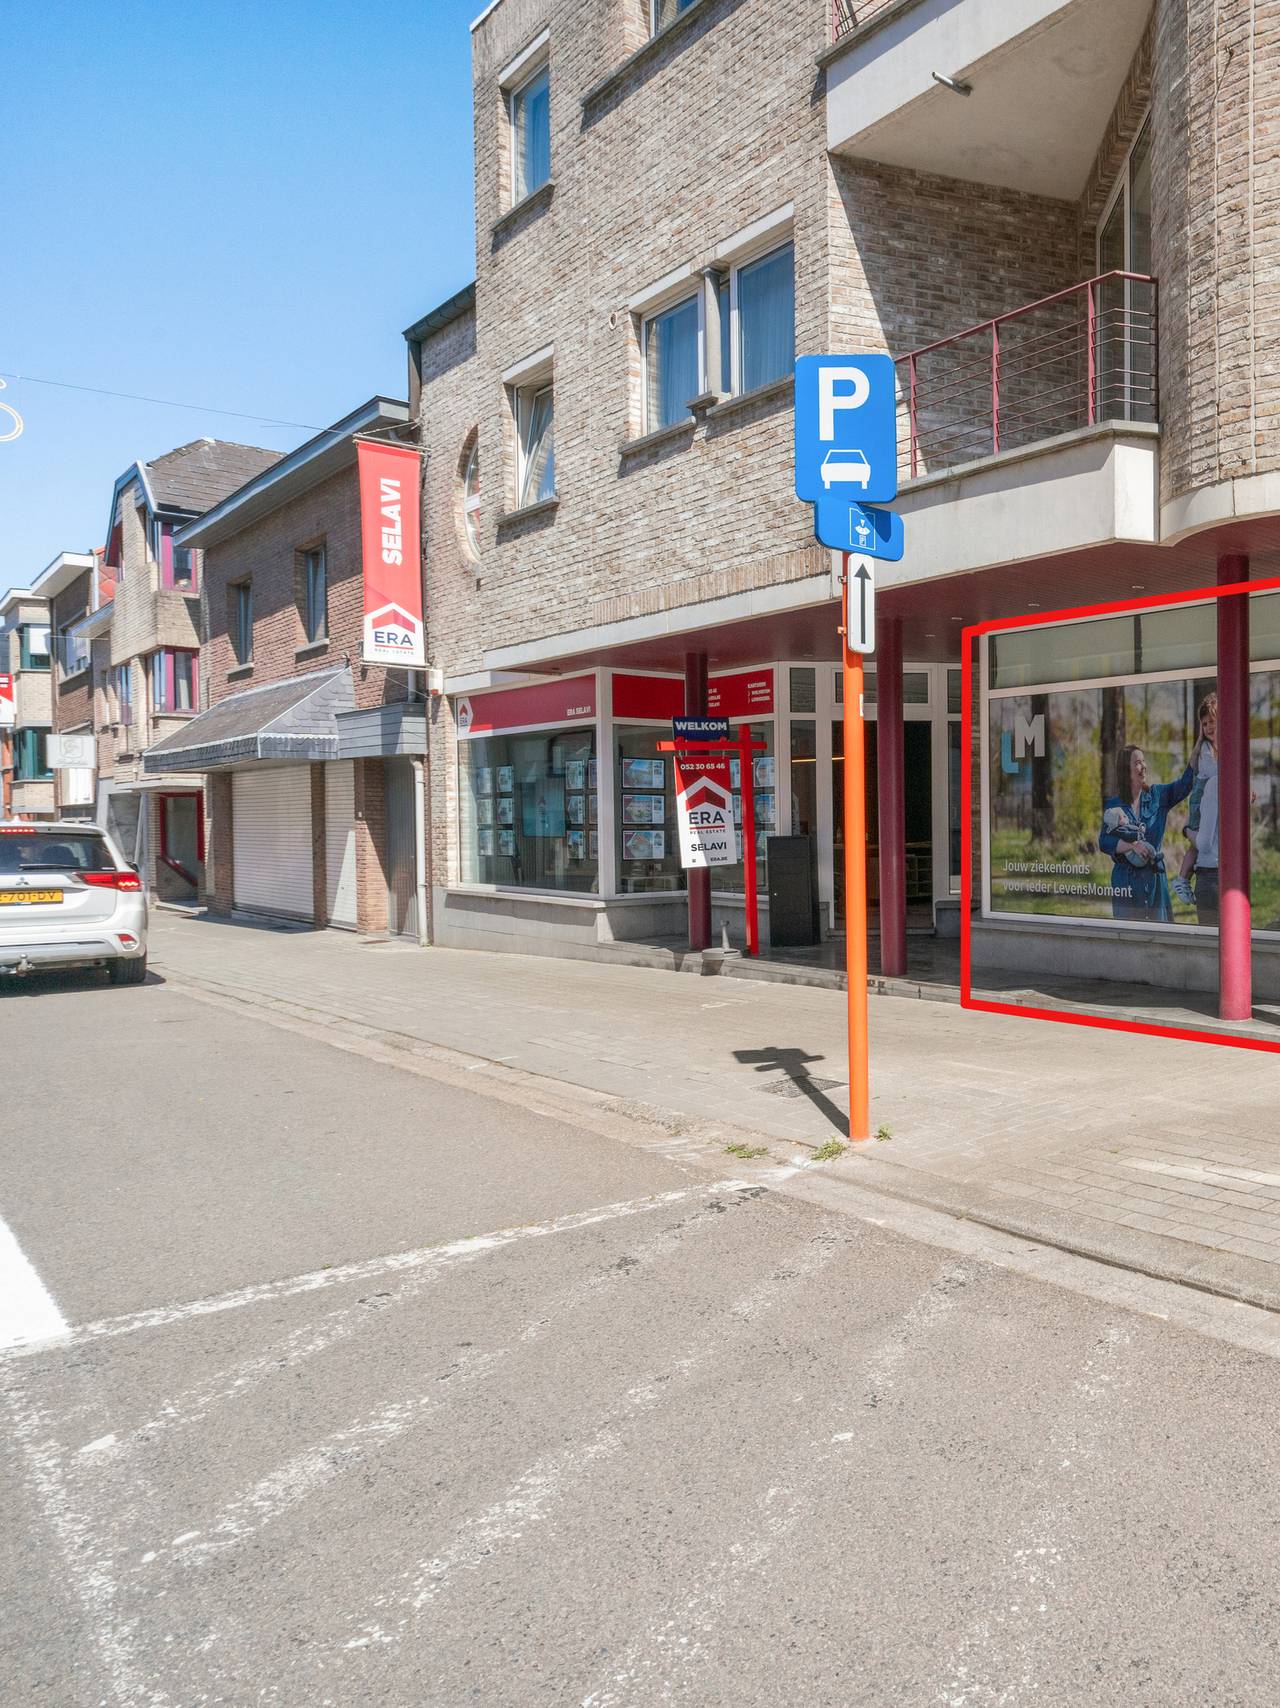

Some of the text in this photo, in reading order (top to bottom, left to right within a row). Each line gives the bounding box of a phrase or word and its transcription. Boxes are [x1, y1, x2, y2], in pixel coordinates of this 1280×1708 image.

[818, 366, 870, 441] P
[380, 477, 402, 566] SELAVI
[374, 631, 413, 646] ERA
[675, 721, 727, 731] WELKOM
[689, 811, 725, 825] ERA
[691, 841, 727, 852] SELAVI
[1002, 859, 1090, 875] Jouw ziekenfonds
[1002, 879, 1133, 898] voor ieder LevensMoment
[0, 892, 56, 901] -701-DV
